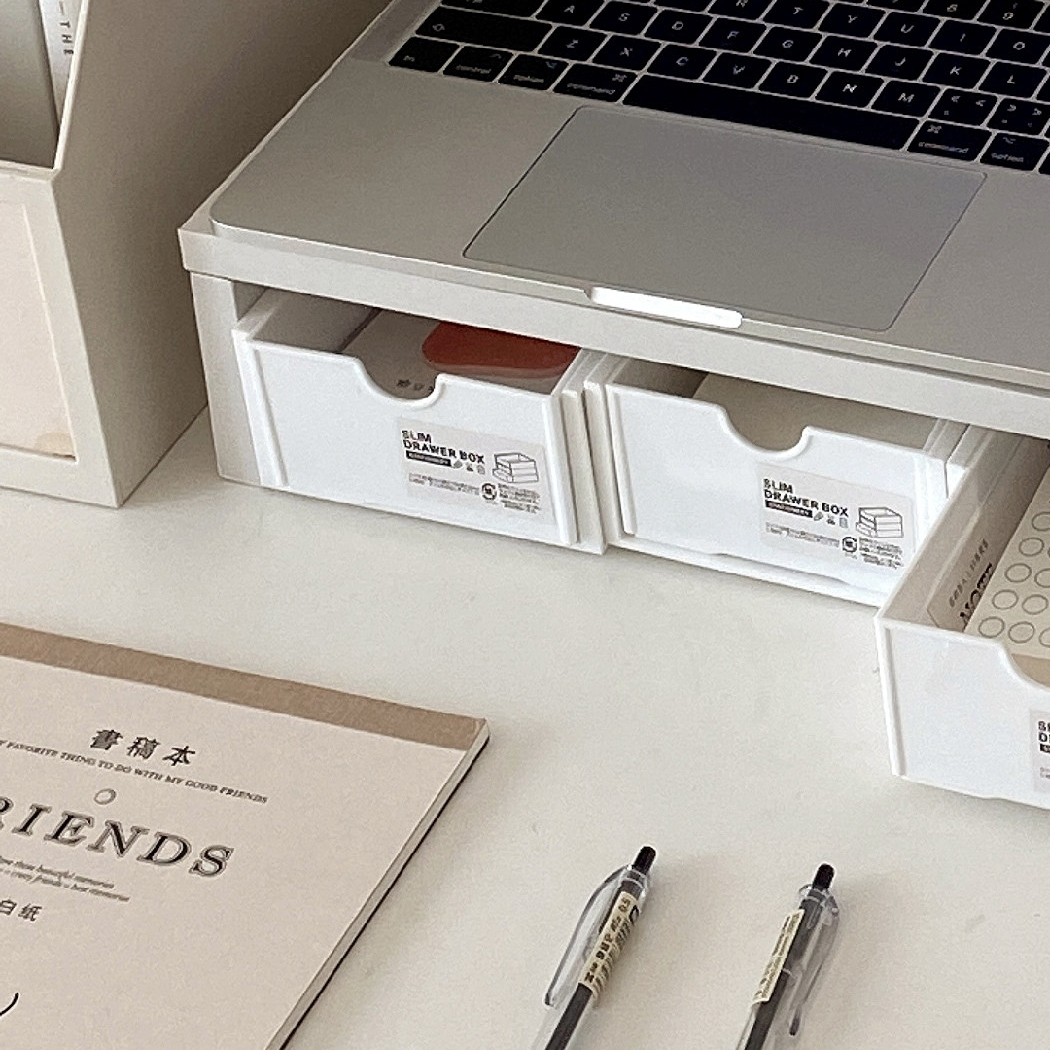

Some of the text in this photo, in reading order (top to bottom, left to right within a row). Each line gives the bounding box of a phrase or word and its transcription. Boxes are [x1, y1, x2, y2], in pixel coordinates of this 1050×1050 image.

[402, 430, 432, 443] SLIM
[403, 440, 457, 459] DRAWER
[460, 450, 485, 464] BOX
[763, 478, 793, 494] SLIM
[764, 489, 819, 510] DRAWER
[822, 502, 848, 517] BOX
[60, 751, 97, 766] THING
[97, 759, 115, 770] TO
[114, 764, 132, 774] DO
[134, 768, 163, 781] WITH
[165, 775, 184, 785] MY
[185, 779, 218, 792] GOOD
[219, 786, 268, 804] FRIENDS
